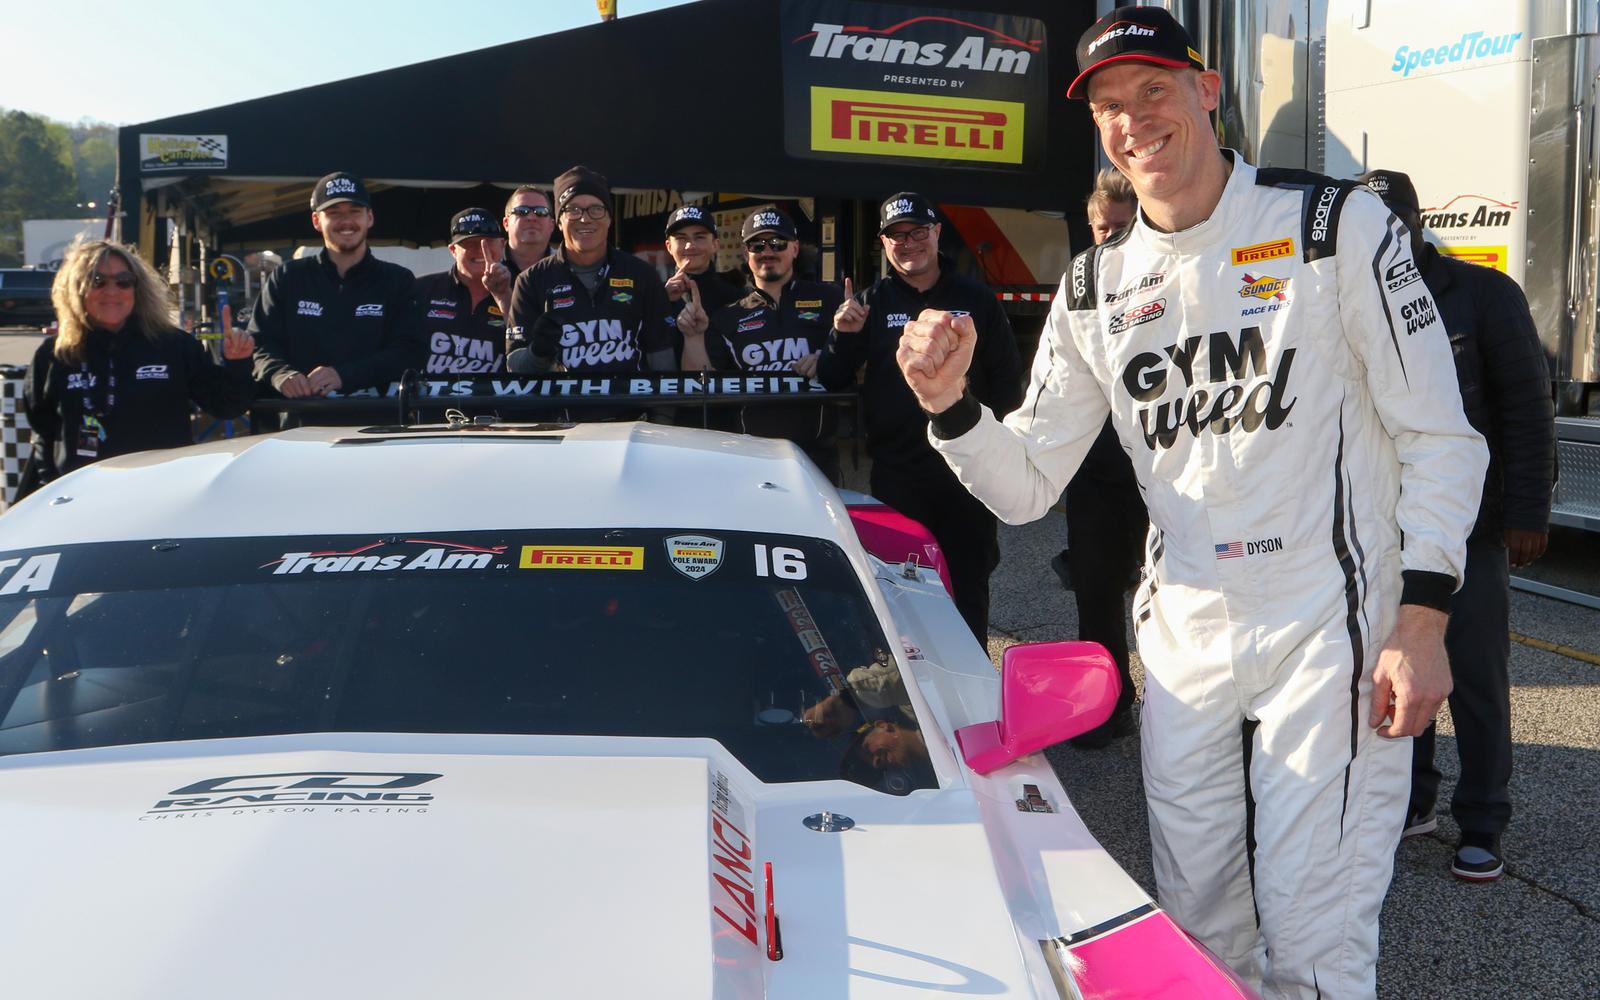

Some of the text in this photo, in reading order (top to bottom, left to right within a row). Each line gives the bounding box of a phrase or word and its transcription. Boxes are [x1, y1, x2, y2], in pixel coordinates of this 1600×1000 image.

[809, 23, 1031, 74] Trans Am
[1088, 25, 1154, 55] Trans Am
[1391, 31, 1522, 77] SpeedTour
[883, 74, 965, 88] PRESENTED BY
[831, 100, 1008, 150] PIRELLI
[326, 178, 351, 188] GYM
[326, 183, 356, 195] weed
[676, 208, 699, 216] GYM
[886, 199, 909, 211] GYM
[886, 202, 913, 220] weed
[1312, 186, 1335, 242] sparco
[675, 212, 702, 221] weed
[753, 212, 776, 220] GYM
[753, 216, 780, 228] weed
[1469, 205, 1511, 227] Am
[1236, 241, 1290, 262] PIRELLI
[1138, 275, 1164, 289] Am
[1243, 280, 1289, 296] SUNOCO
[298, 301, 320, 309] GYM
[1124, 302, 1162, 321] SCCA
[1241, 305, 1266, 317] RACE
[1400, 296, 1430, 320] GYM
[887, 313, 909, 321] GYM
[1110, 311, 1162, 334] PRO RACING
[1406, 300, 1436, 335] weed
[560, 319, 623, 347] GYM
[430, 331, 494, 361] GYM
[562, 330, 635, 368] weed
[742, 337, 811, 366] GYM
[426, 354, 504, 373] weed
[1122, 326, 1268, 403] GYM
[492, 379, 610, 396] WITH
[629, 376, 827, 395] BENEFITS
[1139, 348, 1297, 450] weed
[1247, 537, 1283, 556] DYSON
[272, 552, 407, 574] Trans
[402, 548, 493, 570] Am
[531, 550, 633, 565] PIRELLI
[754, 544, 807, 580] 16
[685, 565, 706, 573] 2024
[153, 792, 434, 809] RACING
[138, 811, 213, 822] CHRIS
[232, 807, 316, 816] DYSON
[712, 809, 758, 945] LANCI
